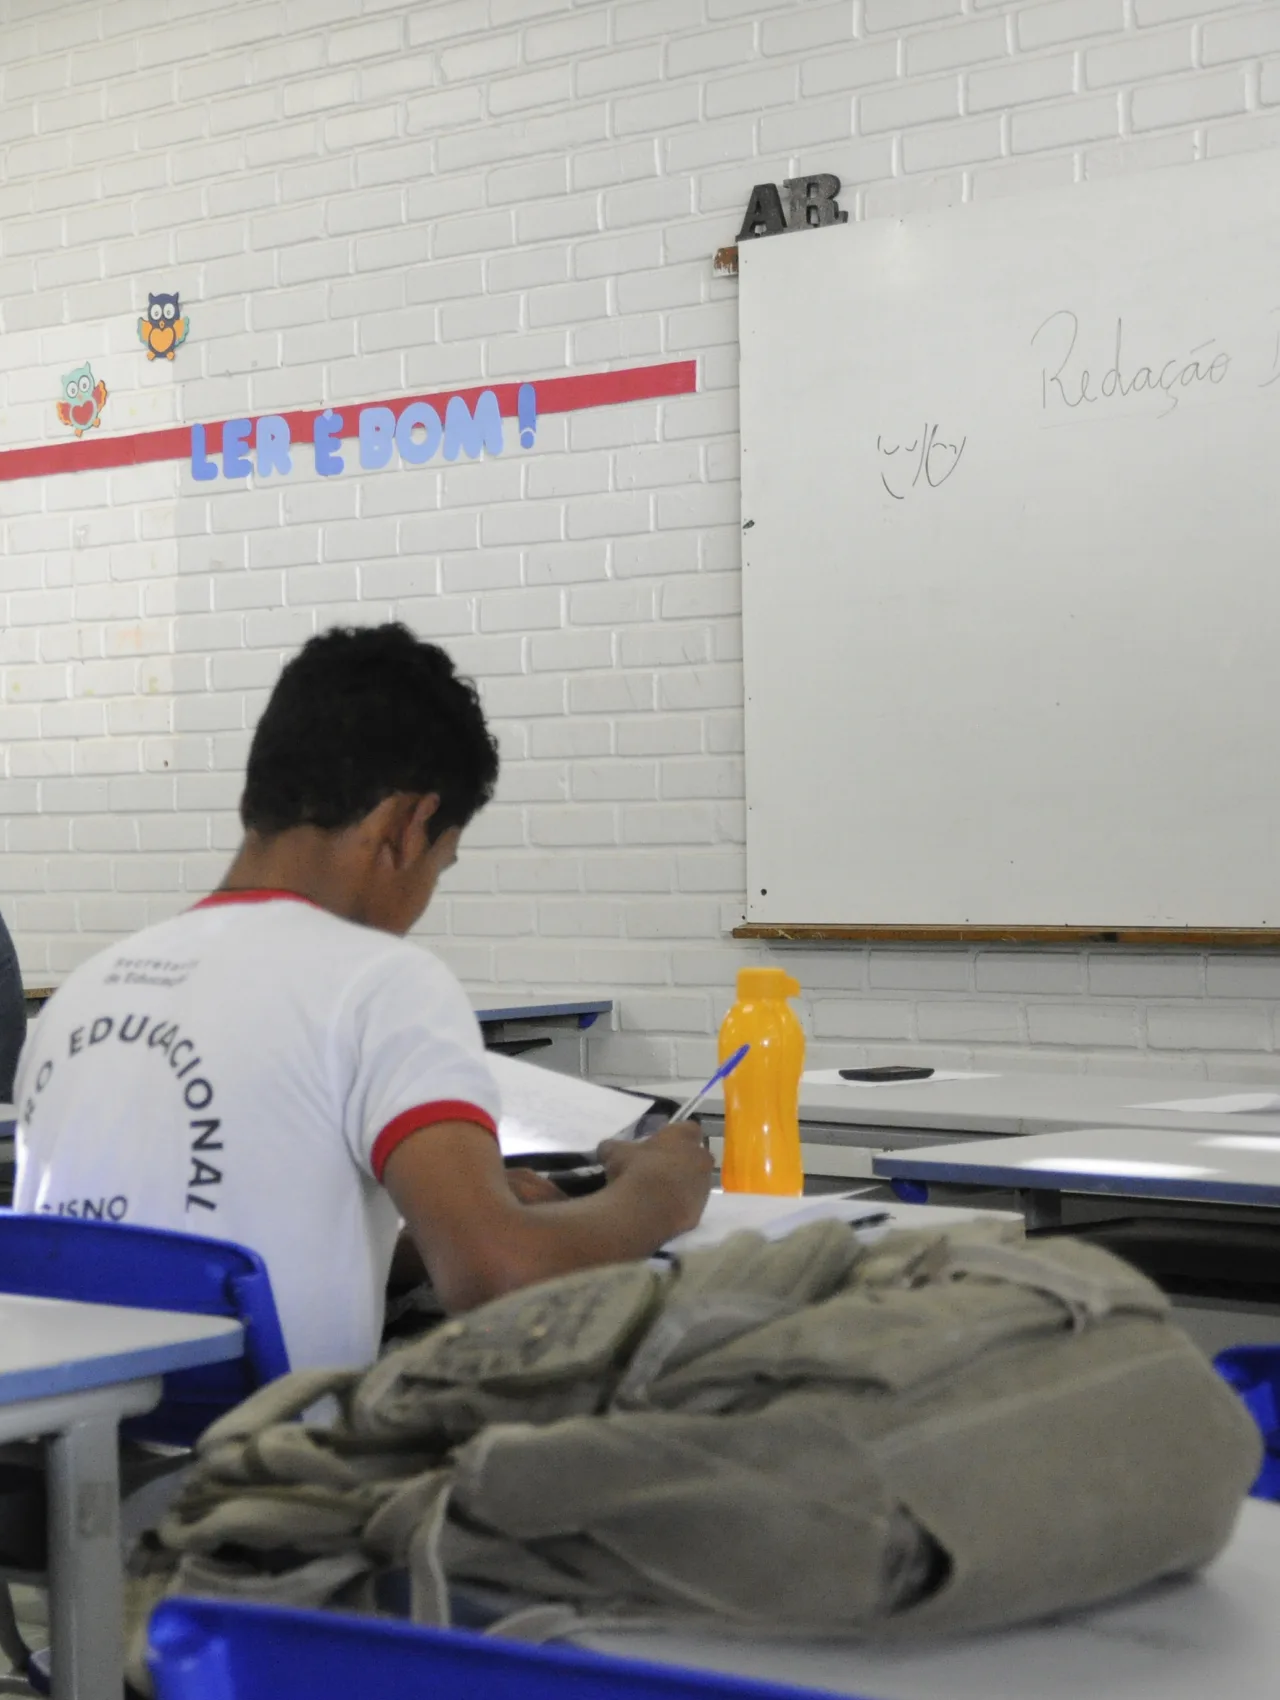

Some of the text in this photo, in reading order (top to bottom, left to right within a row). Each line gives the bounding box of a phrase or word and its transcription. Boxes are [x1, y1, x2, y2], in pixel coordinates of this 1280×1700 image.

[1031, 310, 1232, 419] Redação
[191, 415, 292, 481] LER
[314, 408, 344, 476] É
[69, 1014, 223, 1213] EDUCACIONAL
[41, 1196, 128, 1221] ISNO
